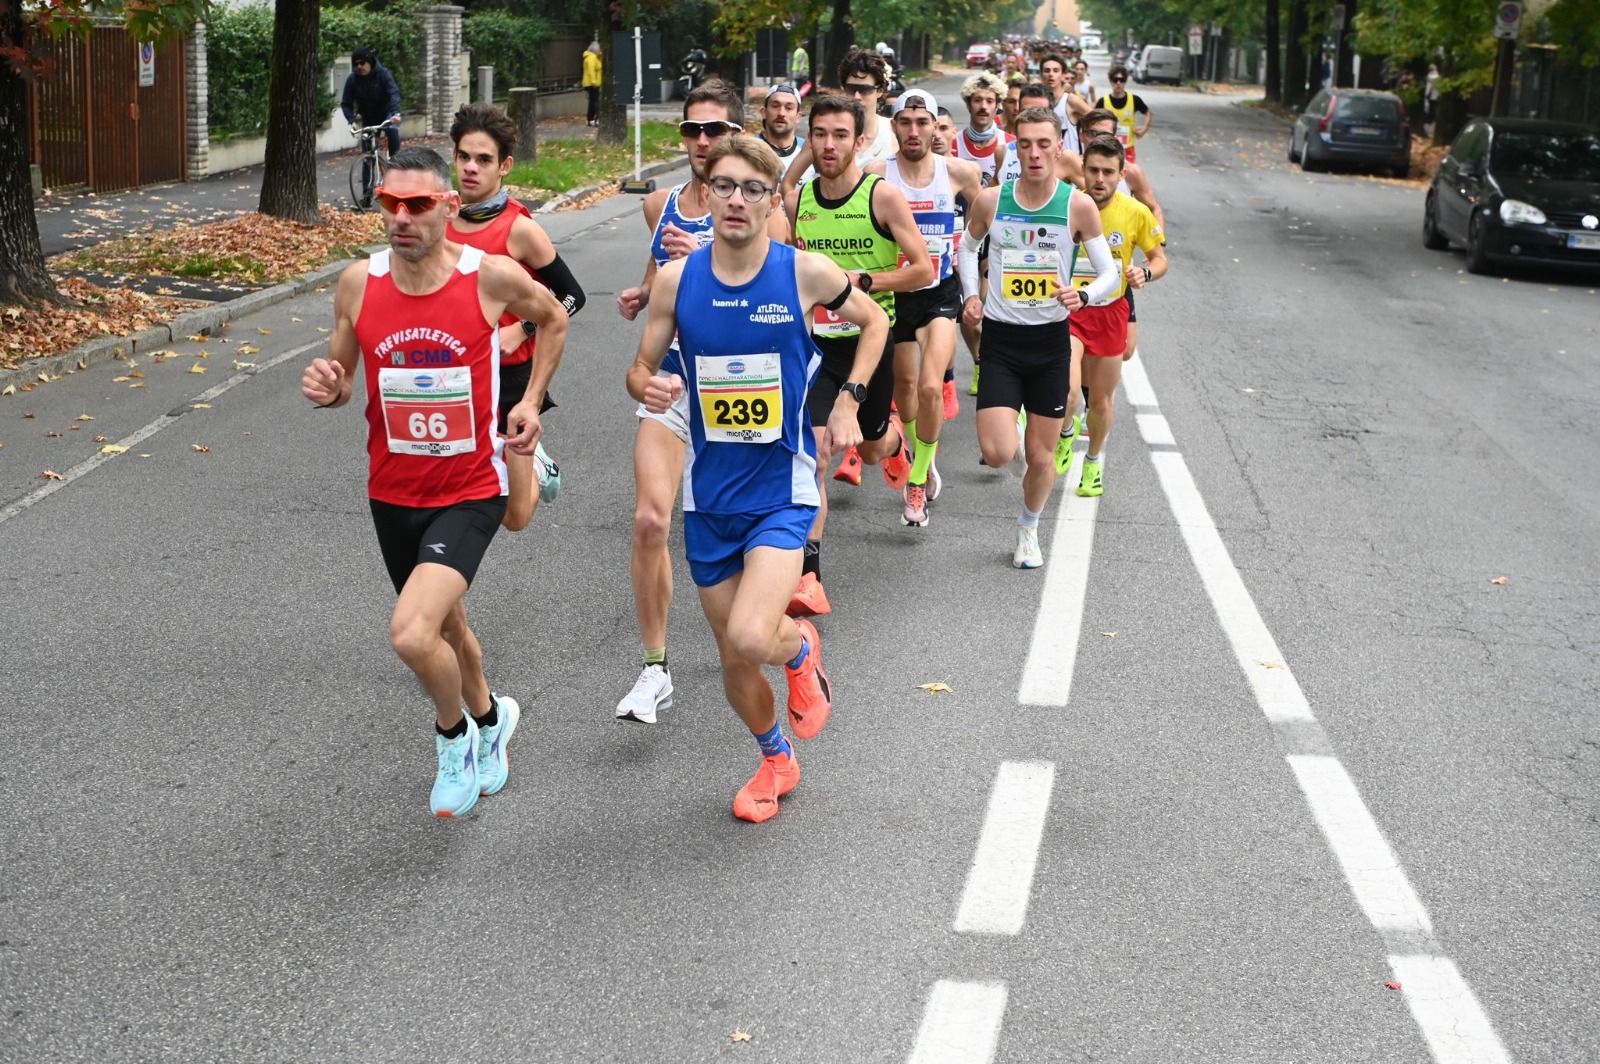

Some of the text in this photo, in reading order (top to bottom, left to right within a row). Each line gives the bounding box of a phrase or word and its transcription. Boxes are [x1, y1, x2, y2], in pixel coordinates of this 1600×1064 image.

[807, 237, 874, 250] MERCURIO
[1010, 278, 1047, 297] 301
[712, 298, 739, 307] luanvi
[757, 303, 789, 314] ATLETICA
[749, 313, 795, 324] CANAVESANA
[374, 327, 467, 360] TREVISATLETICA
[410, 349, 452, 364] CMB
[714, 398, 769, 426] 239
[408, 411, 449, 440] 66
